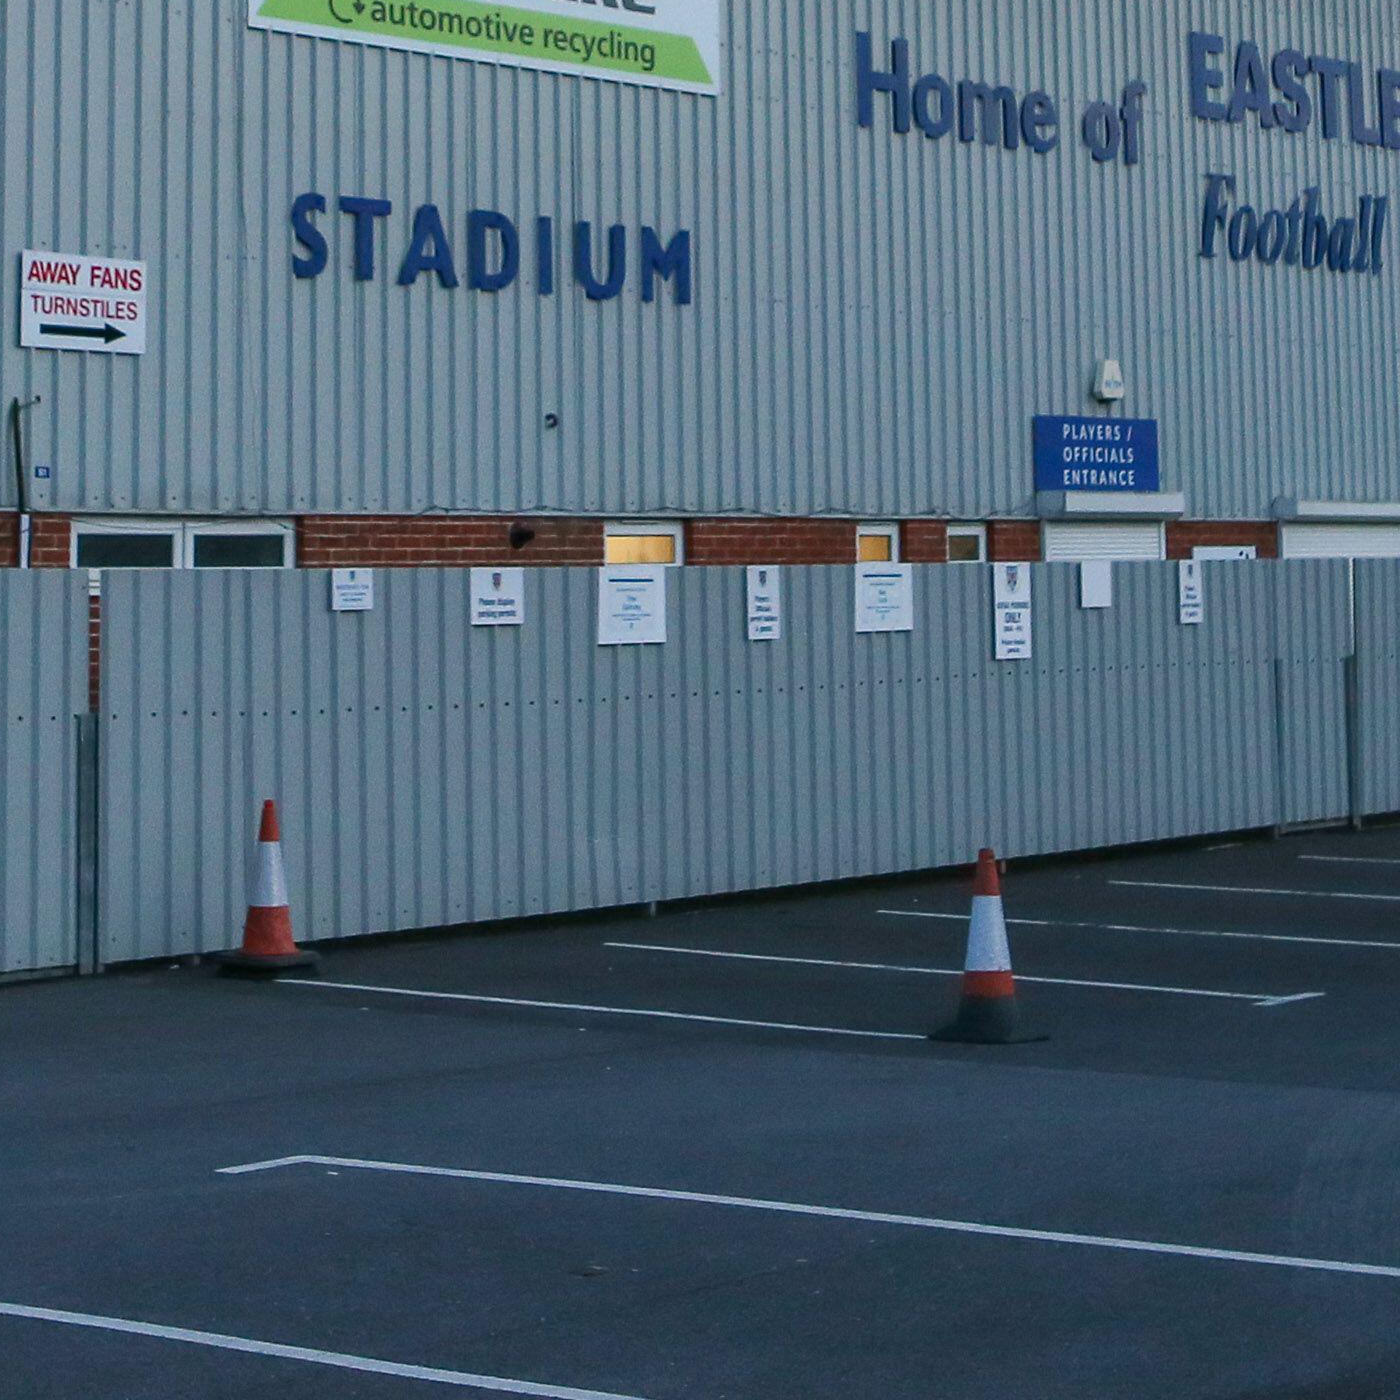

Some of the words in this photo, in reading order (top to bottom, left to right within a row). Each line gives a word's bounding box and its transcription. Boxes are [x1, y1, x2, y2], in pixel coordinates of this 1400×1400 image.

[543, 25, 656, 72] recycling
[856, 31, 1060, 154] Home
[1082, 79, 1147, 166] of
[1199, 173, 1388, 276] Football
[291, 191, 692, 304] STADIUM
[28, 260, 81, 285] AWAY
[90, 265, 142, 291] FANS
[31, 294, 138, 321] TURNSTILES
[1063, 423, 1121, 440] PLAYERS
[1063, 446, 1134, 464] OFFICIALS
[1063, 468, 1135, 486] ENTRANCE
